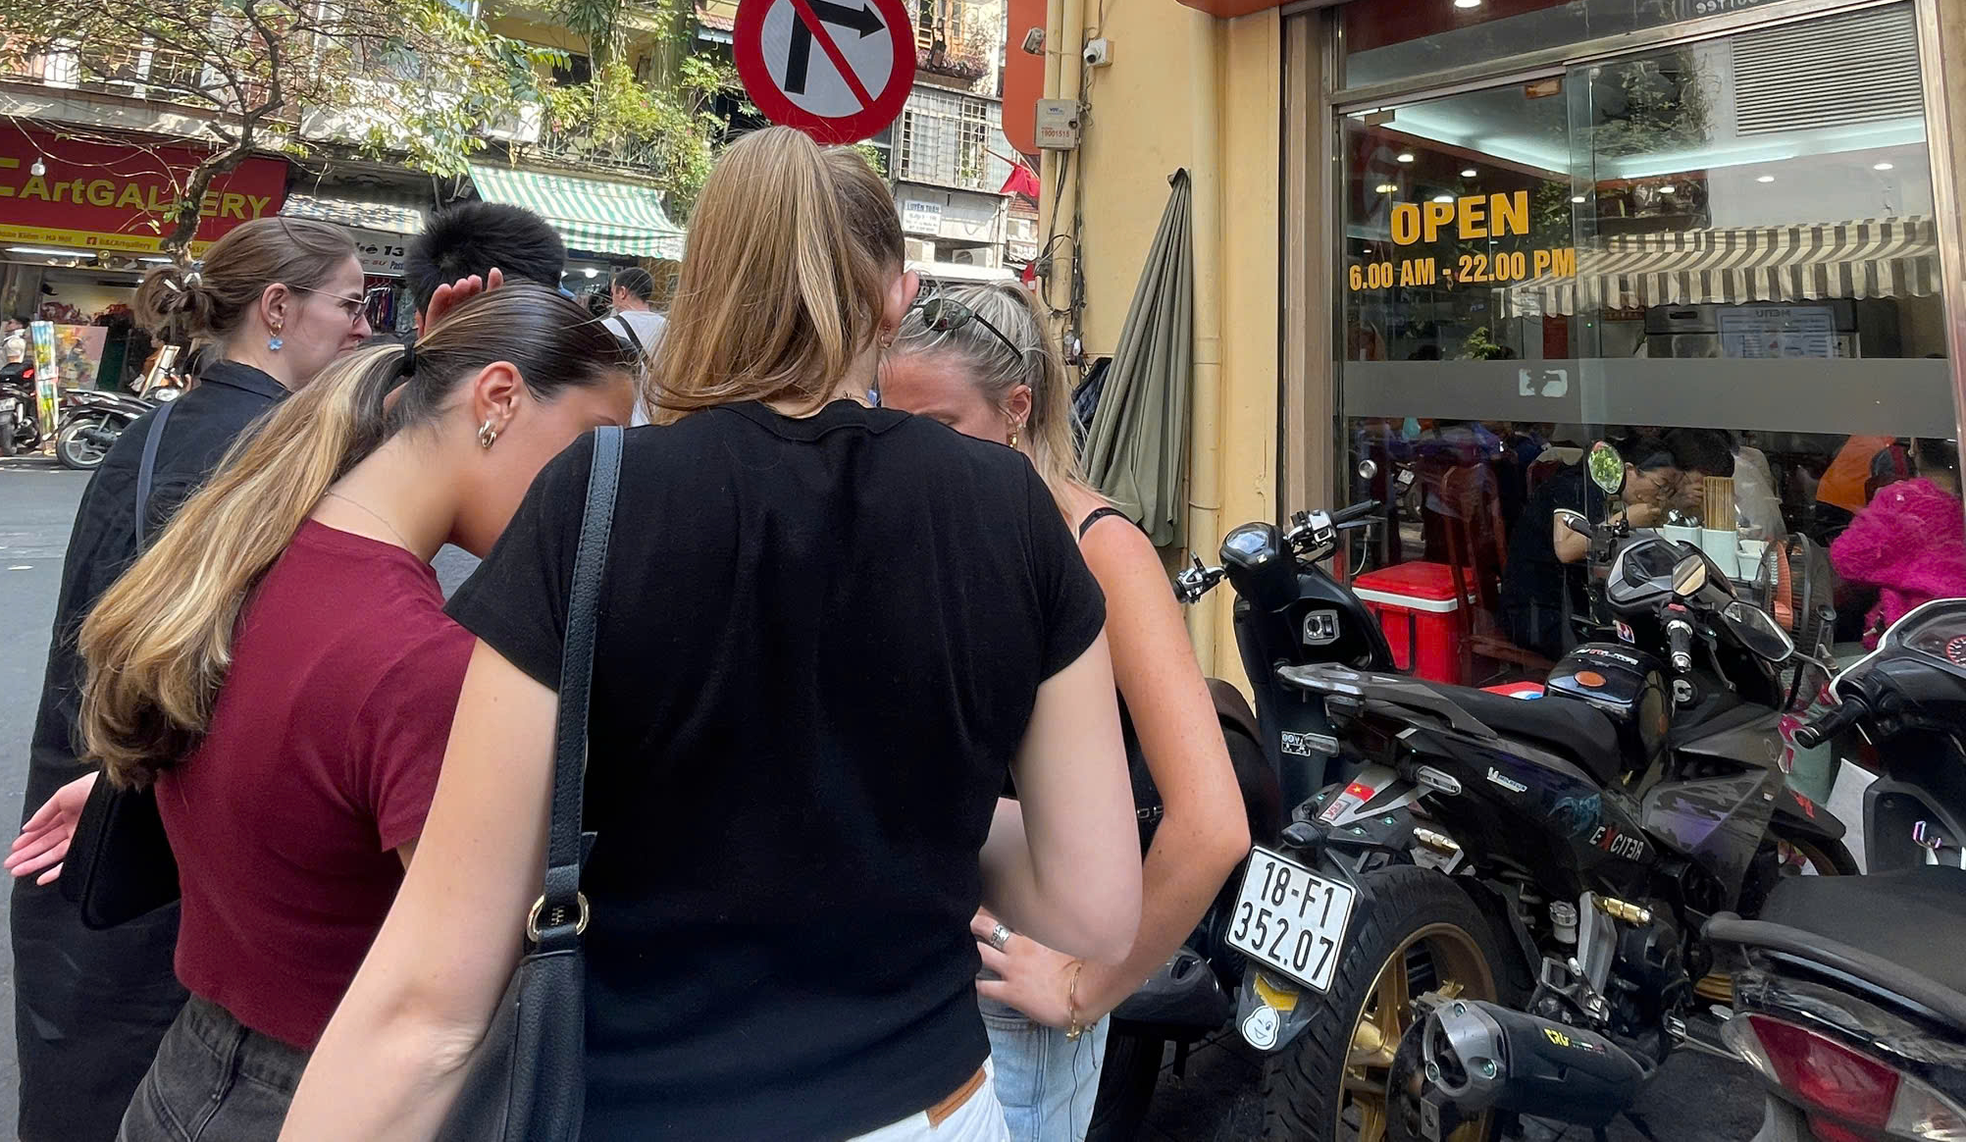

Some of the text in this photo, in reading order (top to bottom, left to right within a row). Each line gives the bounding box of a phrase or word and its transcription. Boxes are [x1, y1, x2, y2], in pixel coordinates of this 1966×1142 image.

[1391, 190, 1529, 245] OPEN
[1350, 262, 1394, 291] 6.00
[1400, 257, 1435, 286] AM
[1458, 251, 1526, 283] 22.00
[1533, 248, 1575, 279] PM
[1261, 861, 1335, 928] 18-F1
[1234, 901, 1334, 981] 352.07
